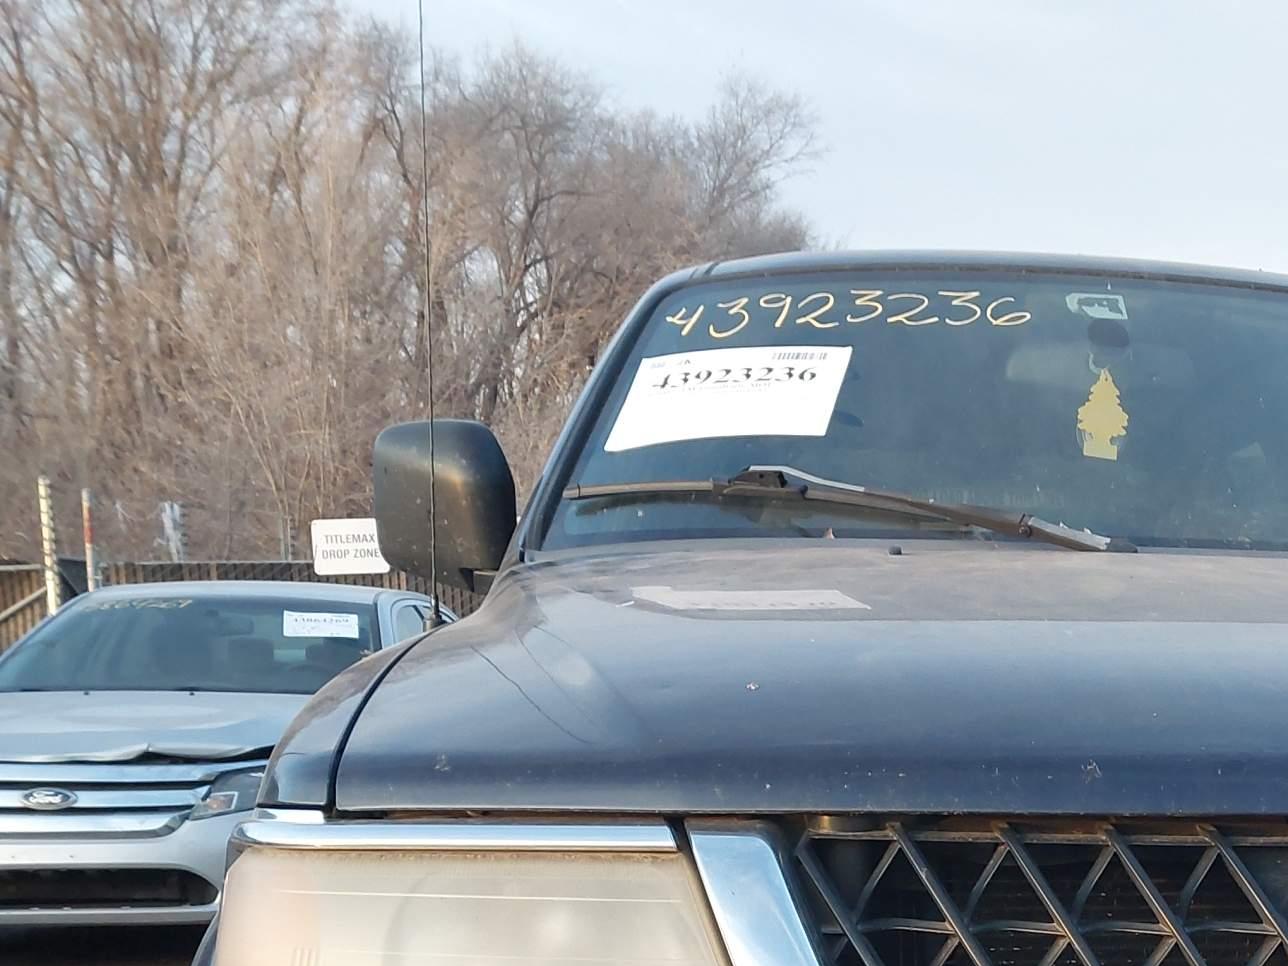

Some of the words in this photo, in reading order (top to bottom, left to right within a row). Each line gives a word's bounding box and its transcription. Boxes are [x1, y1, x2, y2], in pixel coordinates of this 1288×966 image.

[665, 289, 1032, 339] 43923236
[652, 366, 817, 389] 43923236
[323, 533, 376, 545] TITLEMAX
[321, 549, 350, 560] DROP
[353, 548, 380, 559] ZONE
